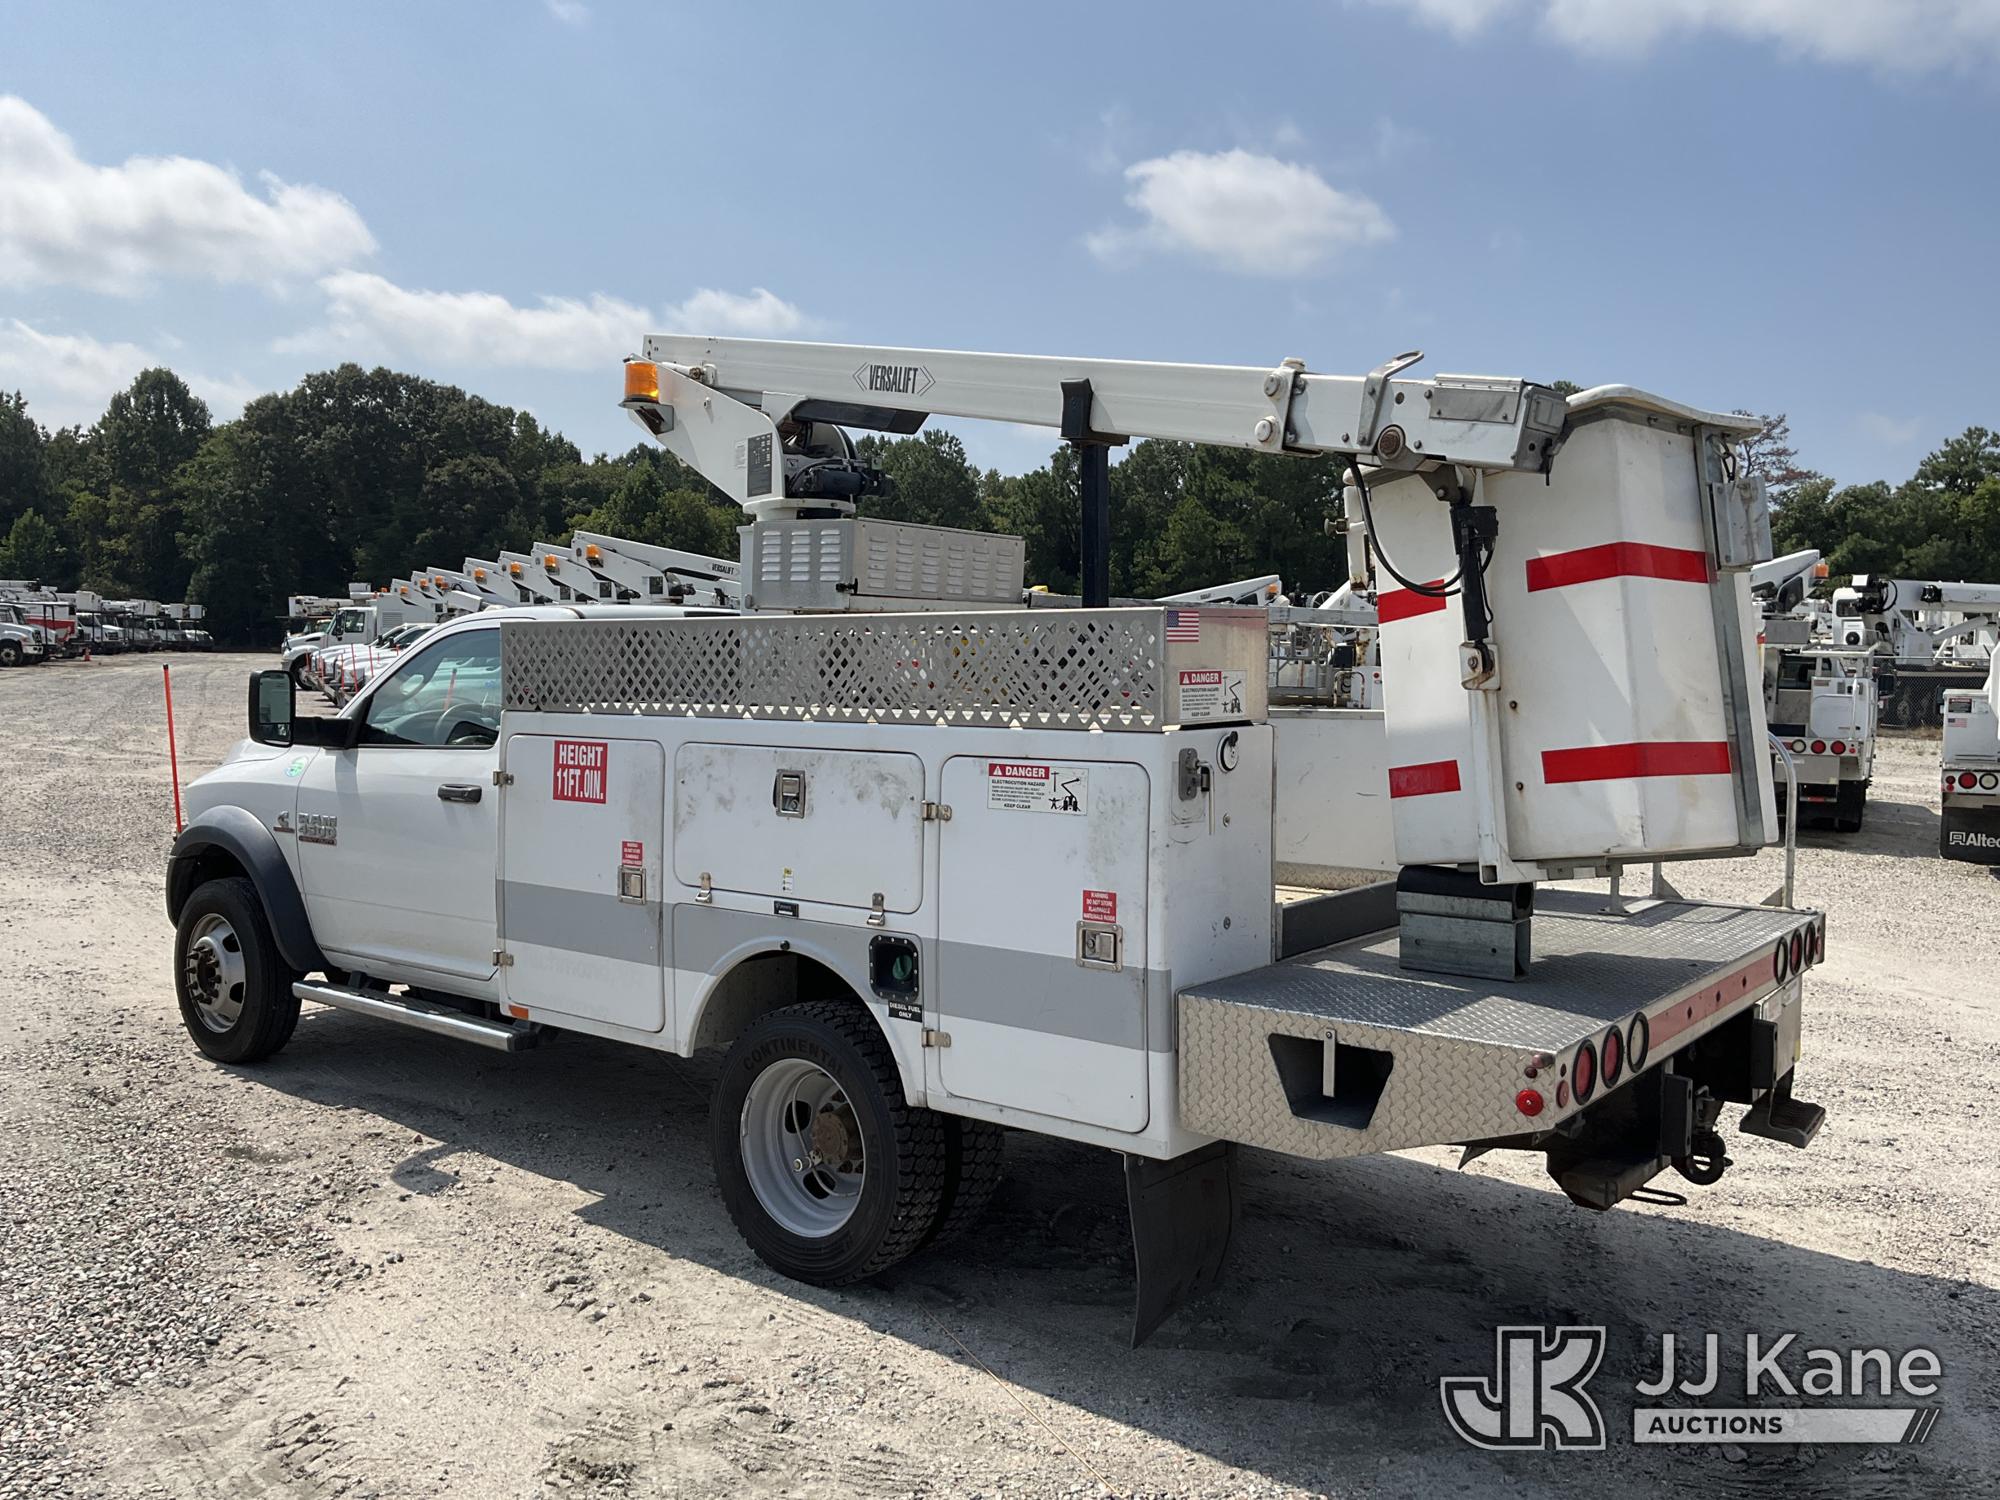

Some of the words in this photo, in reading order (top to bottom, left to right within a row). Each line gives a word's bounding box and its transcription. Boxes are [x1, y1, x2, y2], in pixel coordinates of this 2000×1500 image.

[869, 364, 919, 394] VERSALIFT
[711, 562, 735, 575] VERSALIFT
[1191, 672, 1220, 683] DANGER
[559, 743, 604, 767] HEIGHT
[1005, 766, 1046, 778] DANGER
[890, 1002, 907, 1011] DIESEL
[907, 1005, 921, 1013] FUEL
[899, 1011, 912, 1019] ONLY
